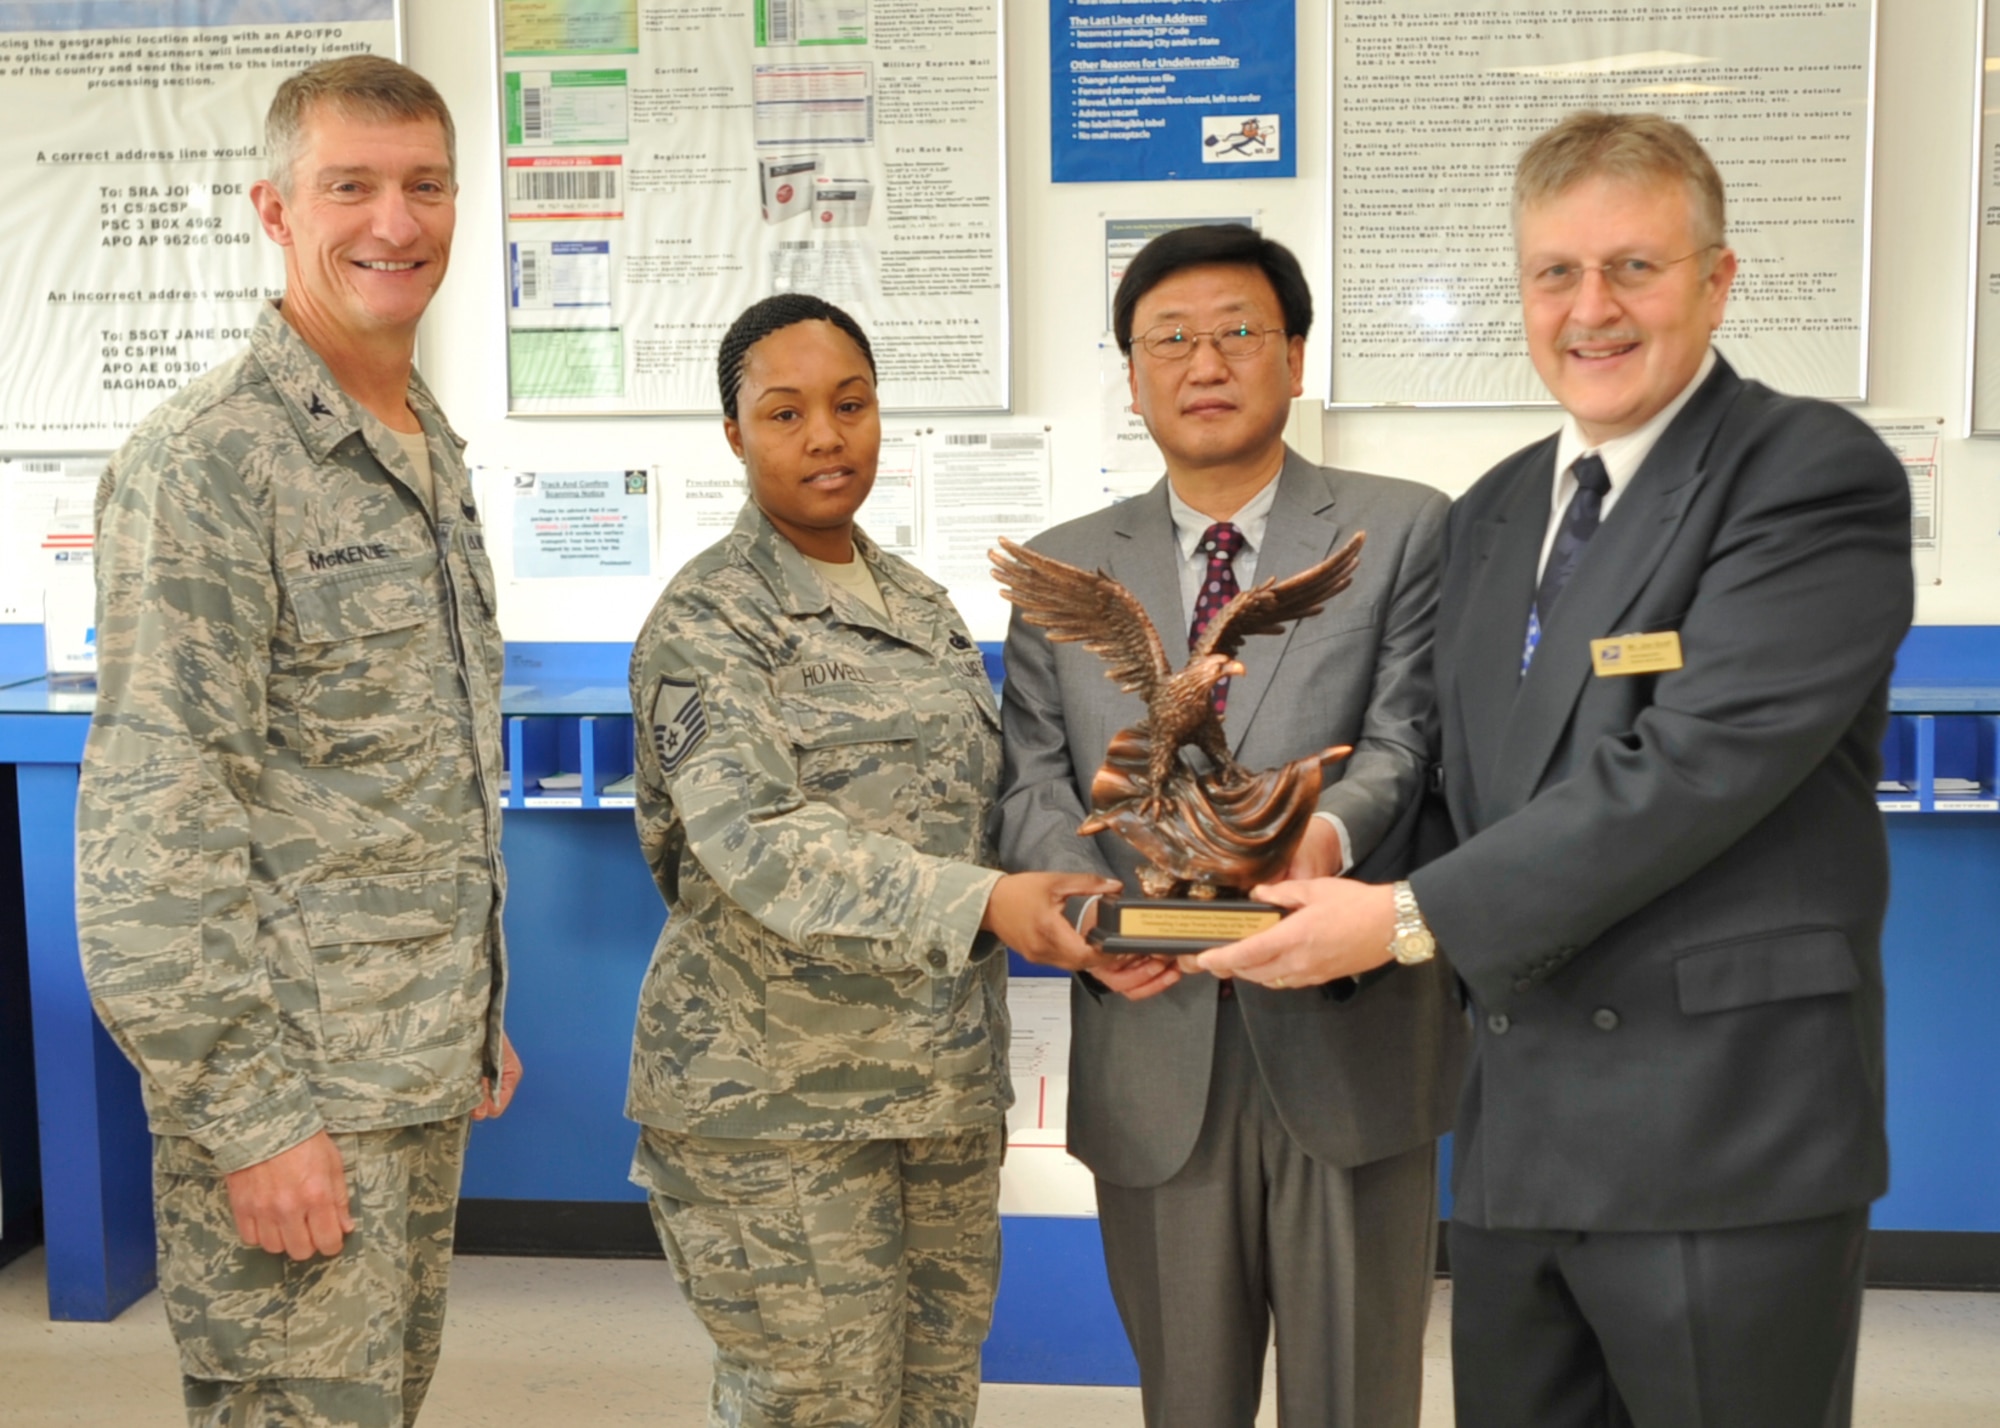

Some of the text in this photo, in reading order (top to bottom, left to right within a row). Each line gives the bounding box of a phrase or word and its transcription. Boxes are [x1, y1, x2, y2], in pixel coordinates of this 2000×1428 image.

[1070, 13, 1207, 26] The Last Line of the Address:
[33, 37, 54, 47] the
[58, 34, 132, 50] geographic
[136, 33, 189, 45] location
[192, 31, 228, 46] along
[231, 30, 260, 41] with
[264, 32, 280, 40] an
[14, 41, 373, 64] optical readers and scanners will immediately identify
[8, 58, 267, 77] of the country and send the item to the
[1070, 57, 1239, 70] Other Reasons for Undeliverability:
[87, 75, 159, 91] processing
[36, 146, 258, 162] A correct address line would
[101, 218, 130, 231] PSC
[136, 218, 145, 230] 3
[101, 232, 250, 247] APO AP 0049
[47, 287, 259, 305] An incorrect address would
[127, 328, 169, 341] SSGT
[175, 328, 215, 340] JANE
[101, 362, 133, 373] APO
[137, 361, 158, 373] AE
